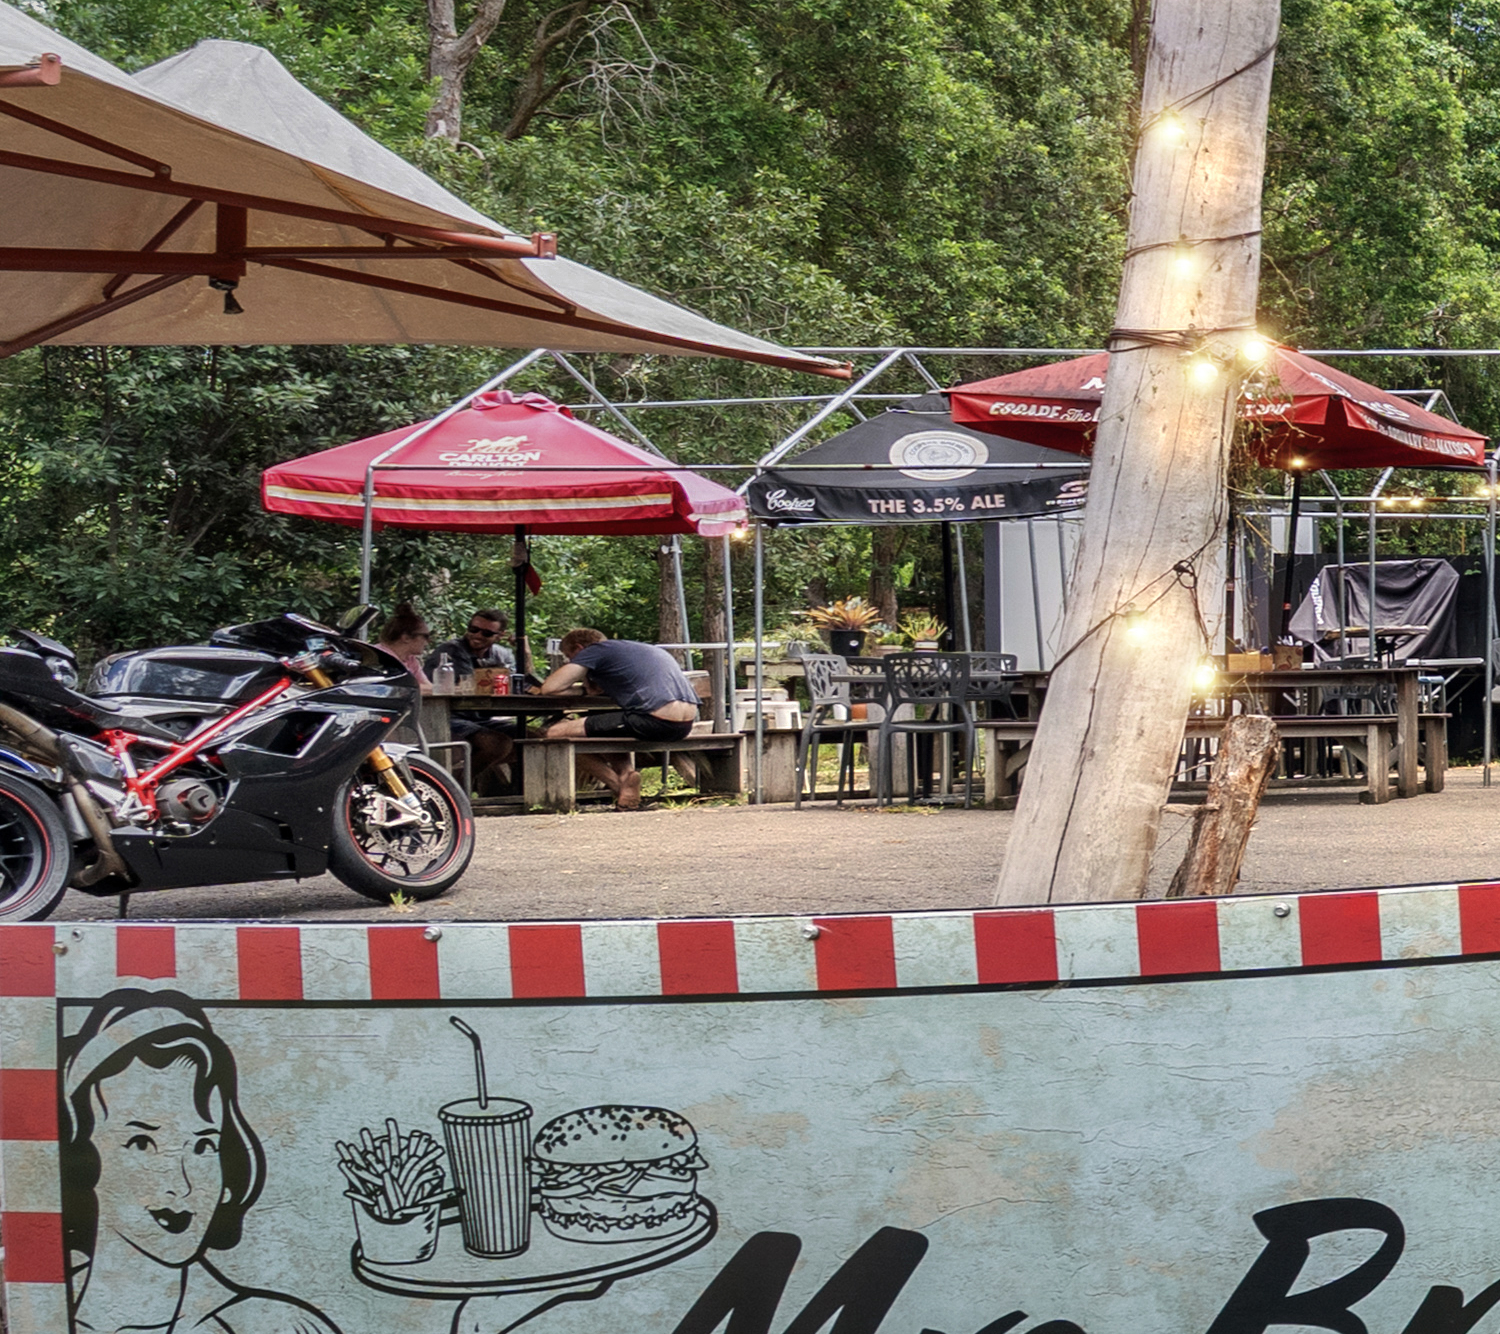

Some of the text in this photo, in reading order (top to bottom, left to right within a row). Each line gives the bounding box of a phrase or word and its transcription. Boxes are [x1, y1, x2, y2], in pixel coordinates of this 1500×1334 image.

[438, 451, 541, 463] CARLTON
[765, 488, 817, 512] Coopers
[867, 494, 1006, 514] THE 3.5% ALE
